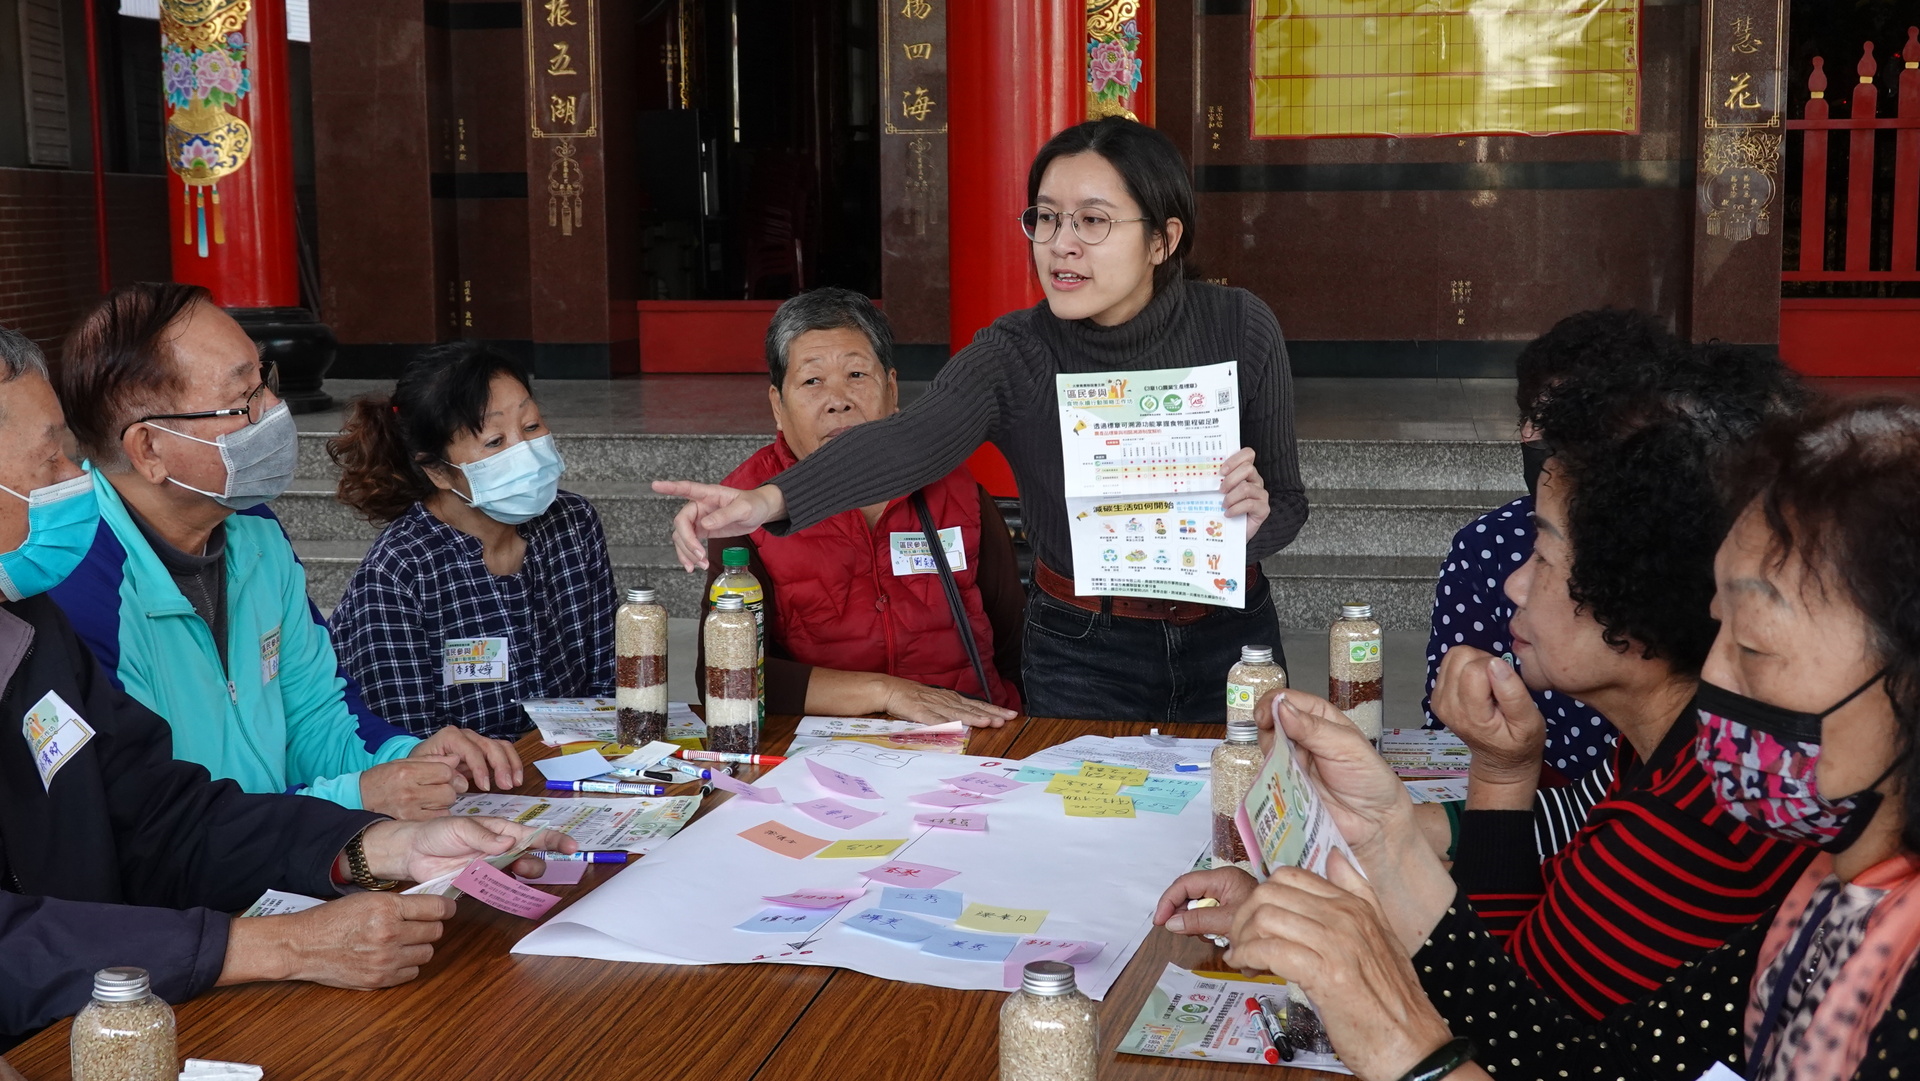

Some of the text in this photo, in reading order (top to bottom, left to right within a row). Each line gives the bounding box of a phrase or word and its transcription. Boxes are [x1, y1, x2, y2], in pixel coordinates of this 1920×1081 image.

[1625, 78, 1634, 96] 姓名
[1625, 107, 1634, 126] 金額
[1067, 388, 1107, 398] 區民參與
[1093, 502, 1174, 513] 減碳生活如何開始
